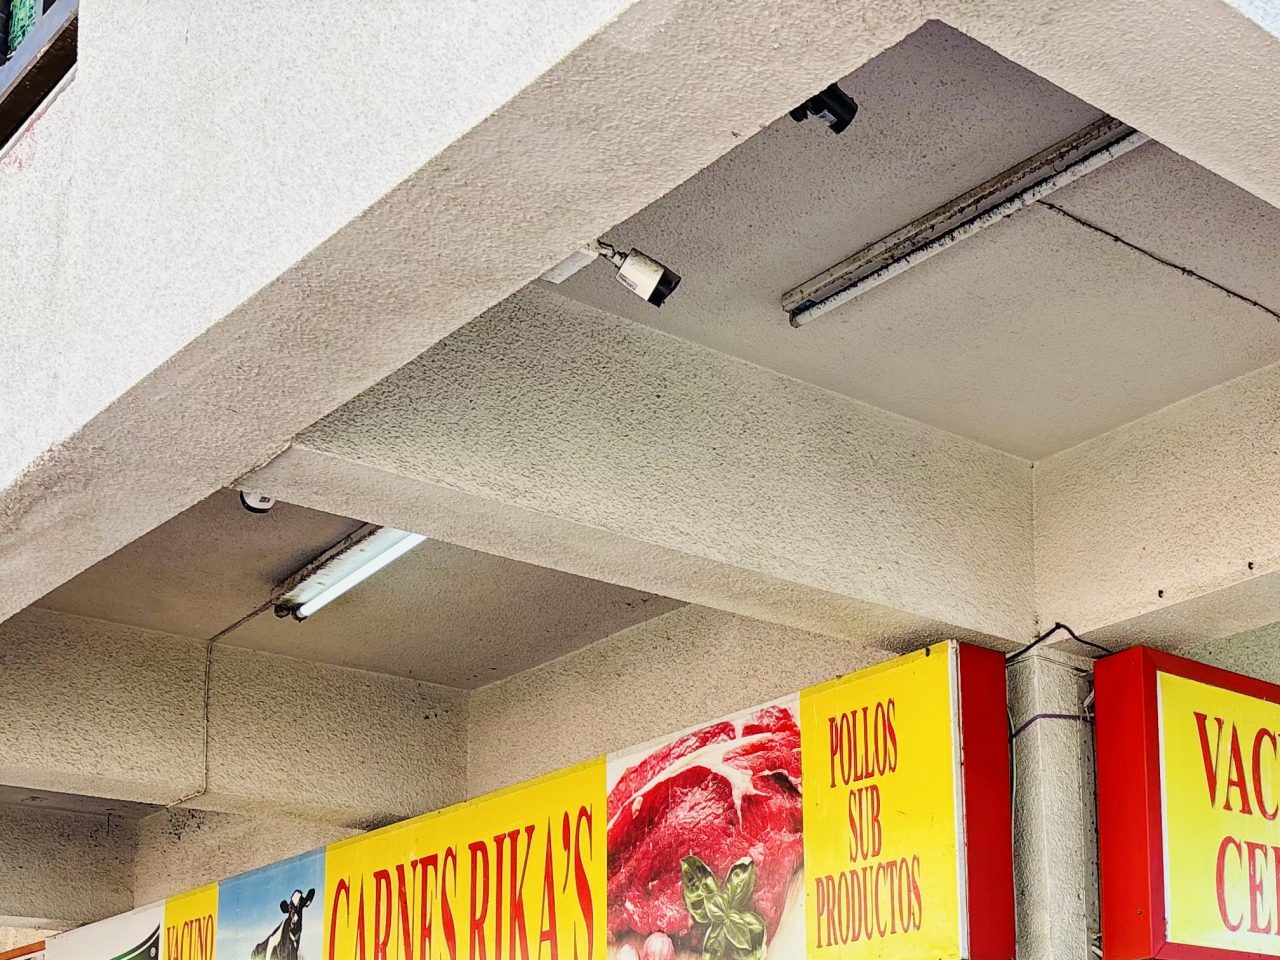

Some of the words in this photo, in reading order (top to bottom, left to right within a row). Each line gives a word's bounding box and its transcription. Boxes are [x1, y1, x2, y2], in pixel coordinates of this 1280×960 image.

[828, 697, 898, 788] POLLOS
[848, 783, 882, 862] SUB
[815, 853, 924, 949] PRODUCTOS
